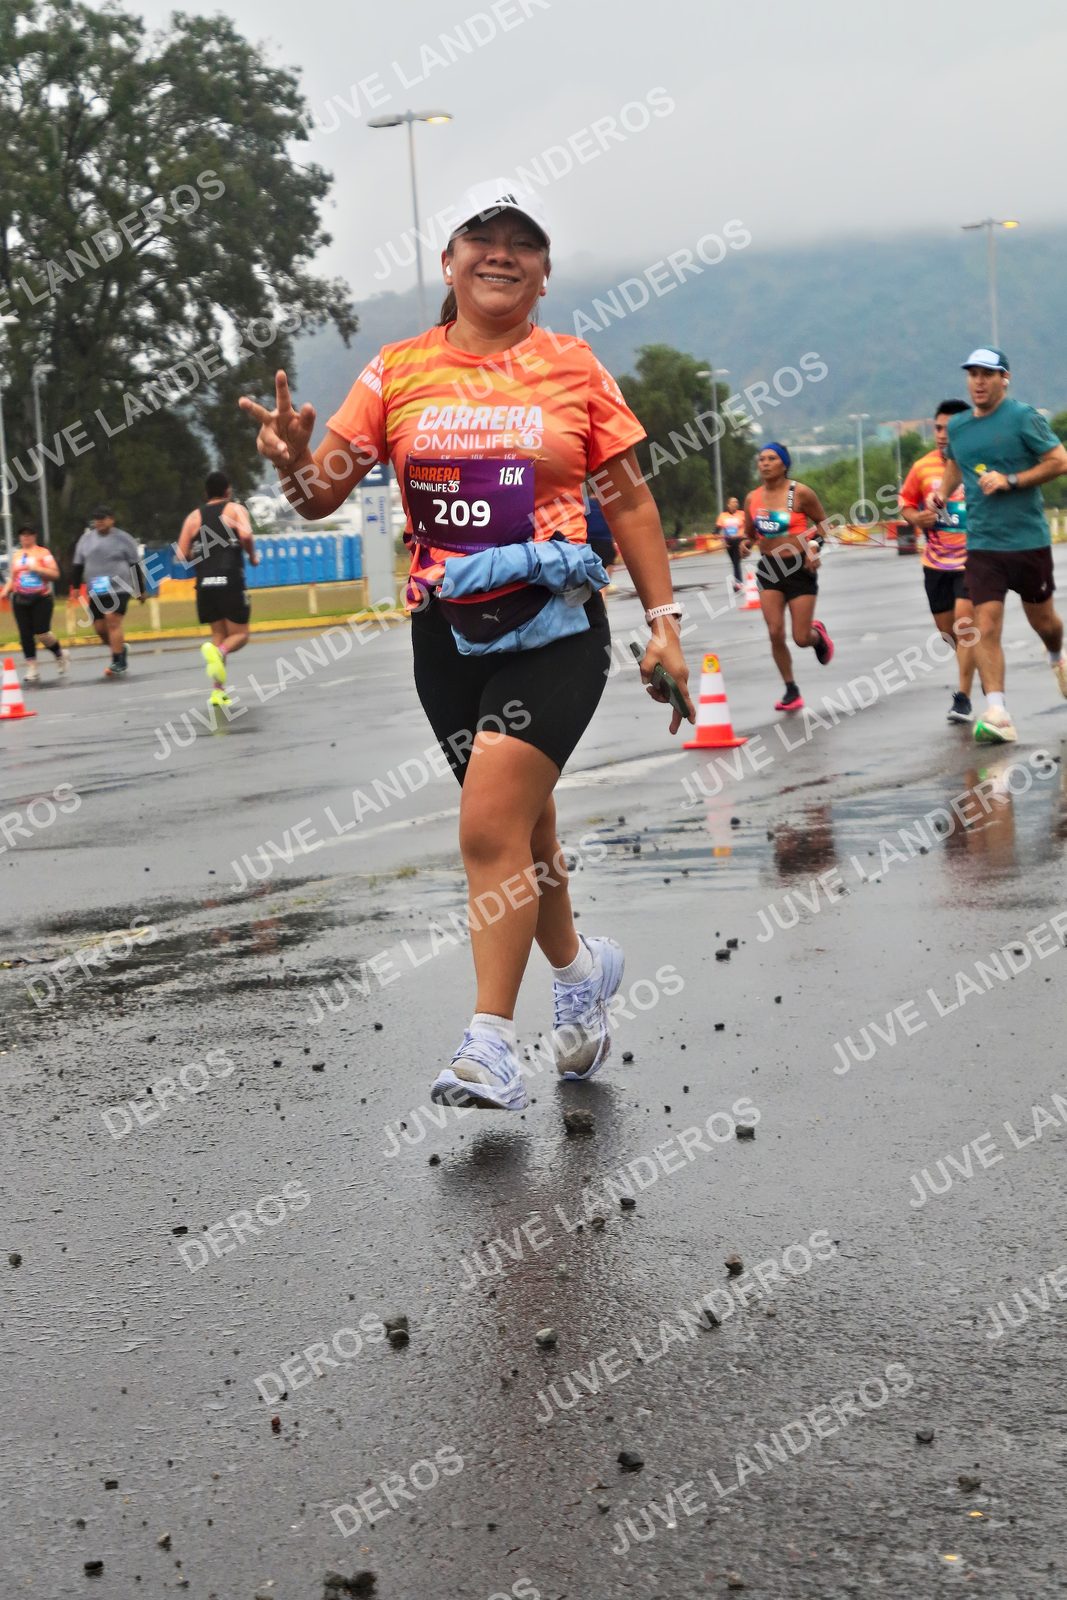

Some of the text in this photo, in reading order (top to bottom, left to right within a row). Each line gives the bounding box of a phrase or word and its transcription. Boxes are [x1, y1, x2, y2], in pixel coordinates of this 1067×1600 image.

[417, 405, 543, 430] CARRERA
[413, 434, 514, 450] OMNILIFE
[409, 465, 525, 486] CARRERA 15K
[410, 479, 447, 493] OMNILIFE
[432, 499, 491, 527] 209
